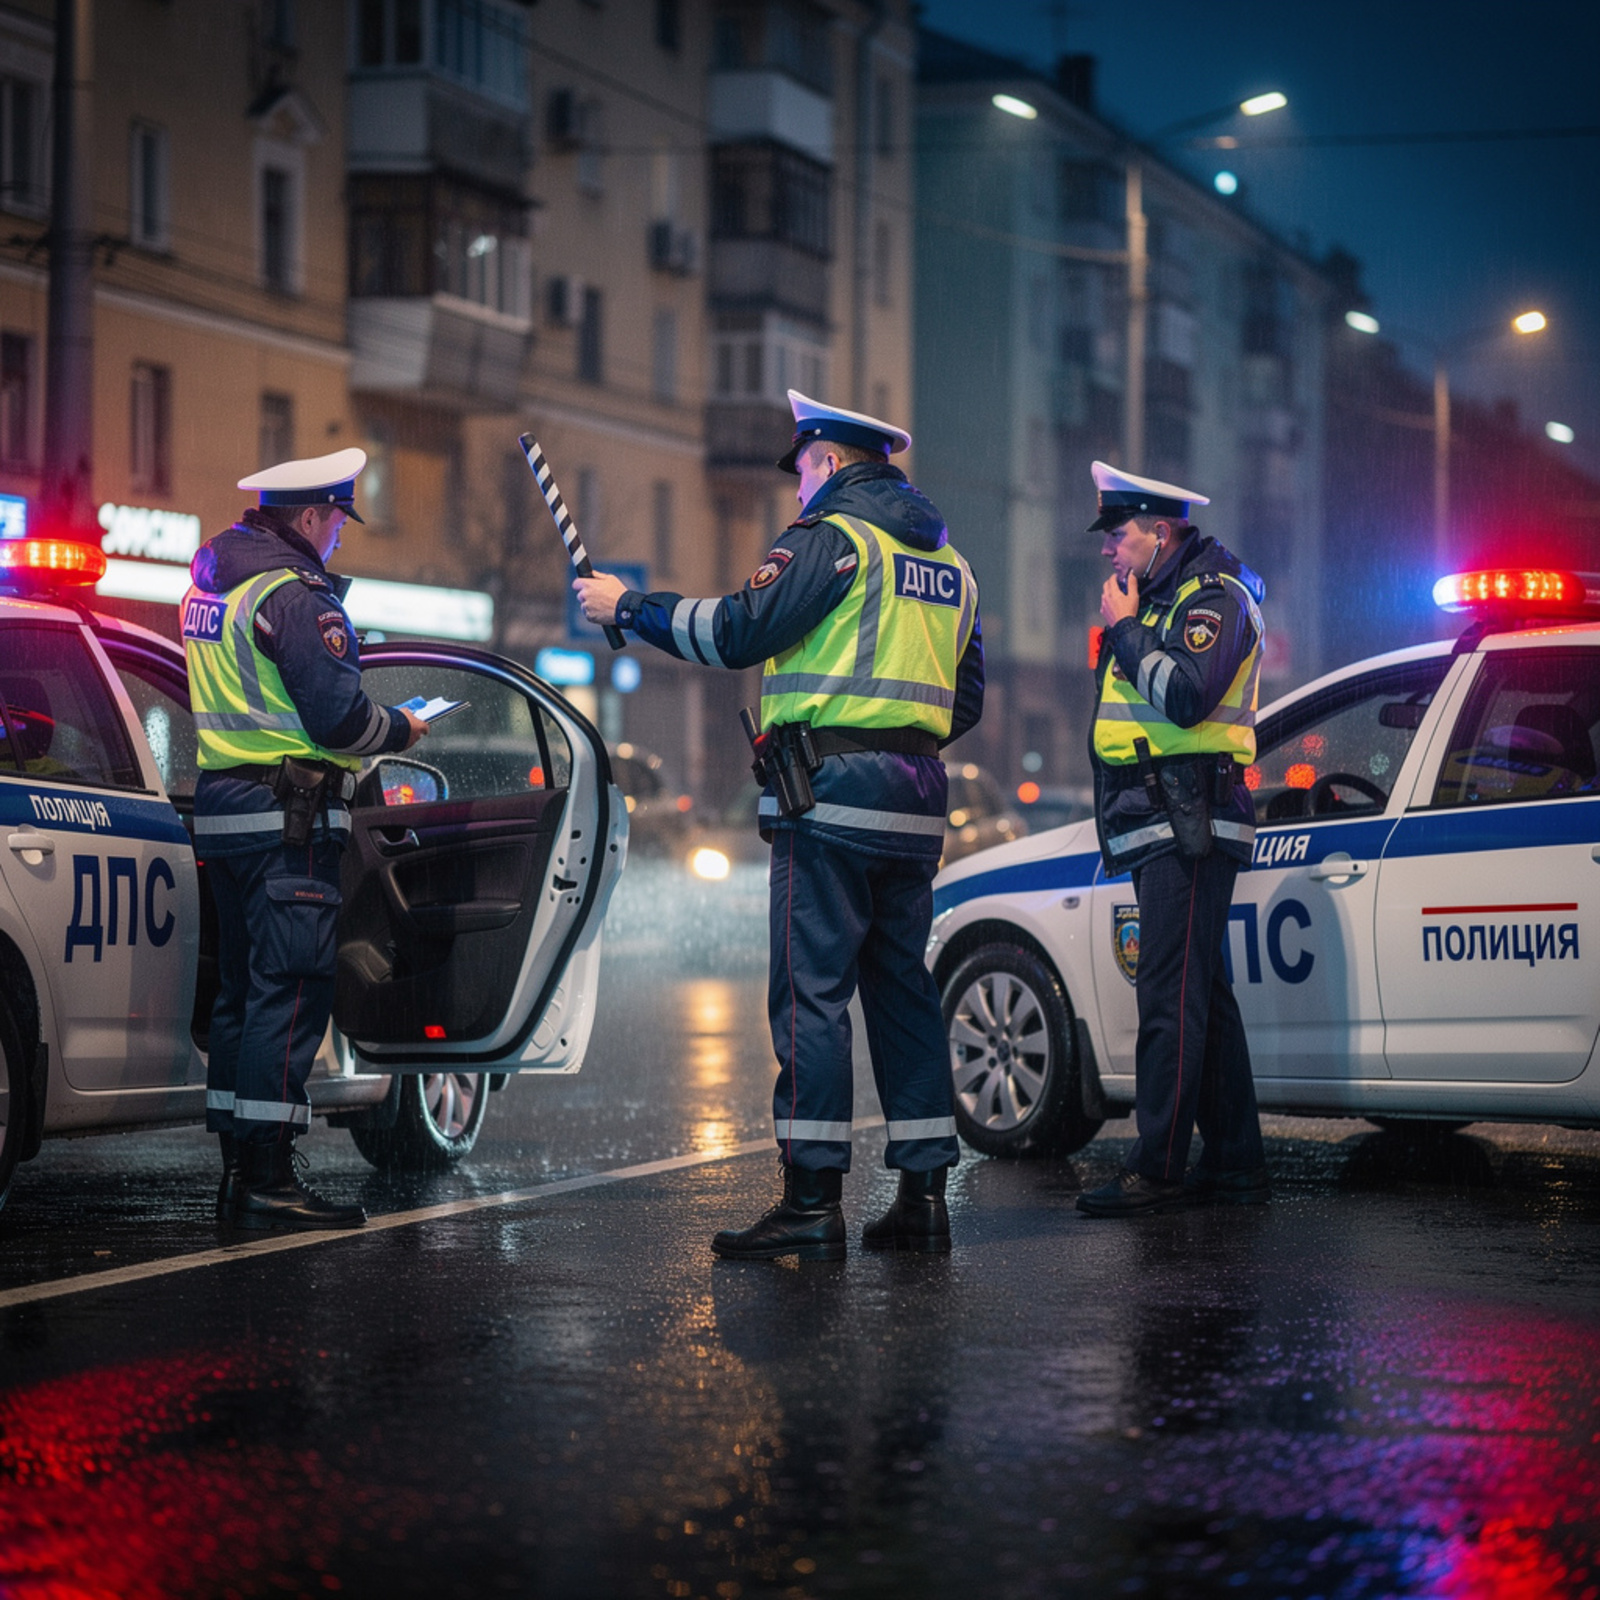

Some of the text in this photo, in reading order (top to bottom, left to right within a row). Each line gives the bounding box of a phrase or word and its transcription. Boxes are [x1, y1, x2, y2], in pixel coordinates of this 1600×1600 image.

[902, 560, 955, 599] ДПС
[184, 602, 220, 636] ДПС
[1251, 834, 1312, 867] ЦИЯ
[64, 854, 176, 963] ДПС
[1221, 898, 1315, 984] ПС
[1422, 923, 1579, 967] ПОЛИЦИЯ
